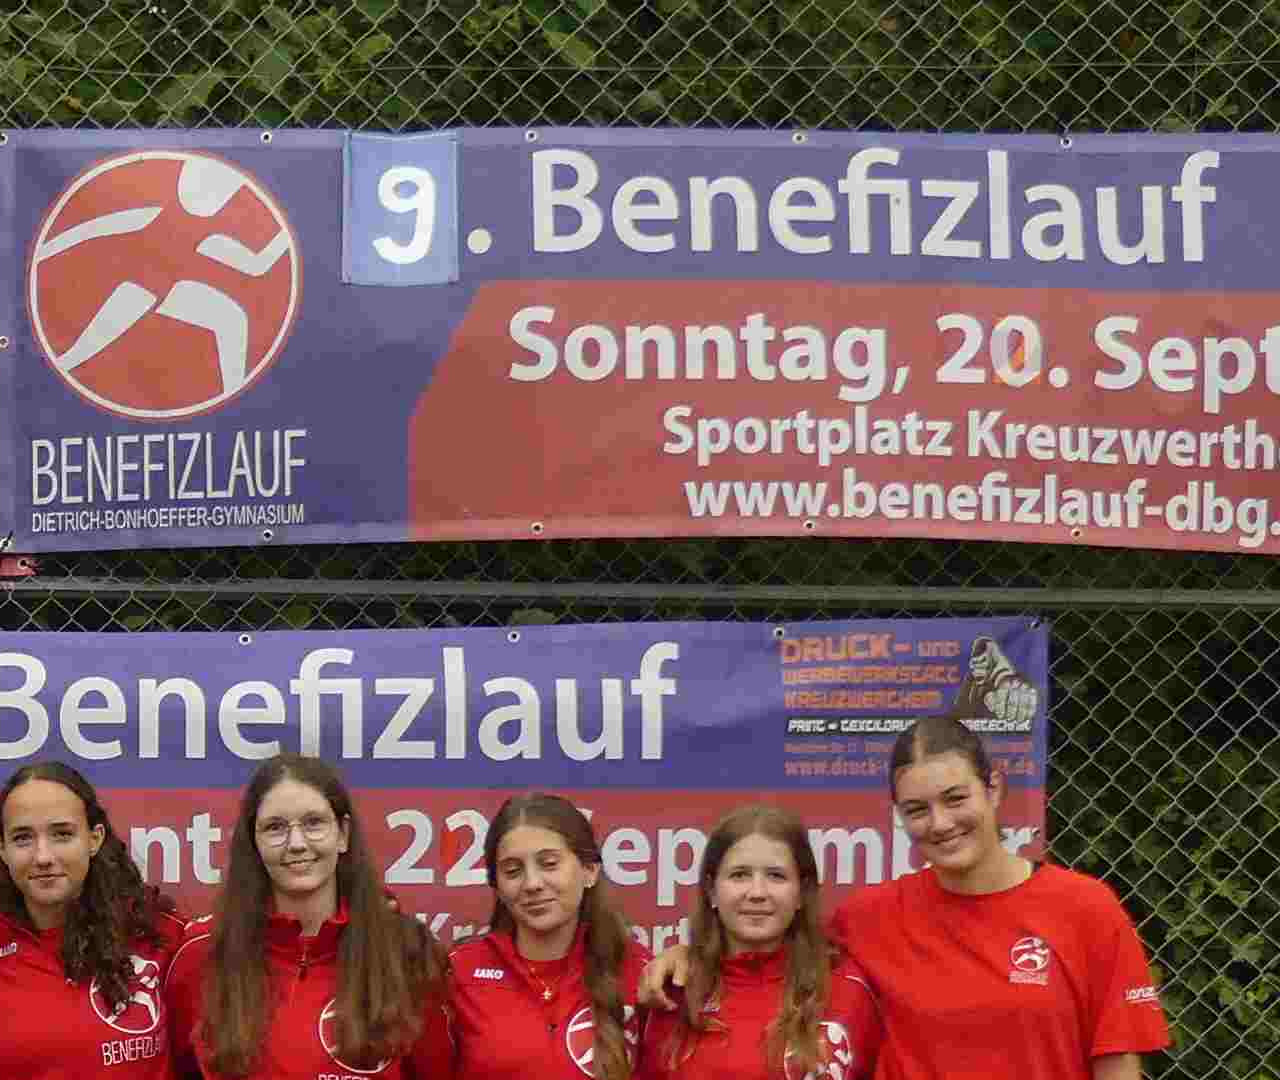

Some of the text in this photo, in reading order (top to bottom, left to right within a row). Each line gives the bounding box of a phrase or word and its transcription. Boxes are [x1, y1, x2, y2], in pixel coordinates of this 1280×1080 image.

[372, 147, 1221, 265] 9. Benefizlauf
[509, 305, 1280, 414] Sonntag, 20. Sept
[31, 429, 307, 505] BENEFIZLAUF
[663, 404, 1280, 471] Sportplatz Kreuzwerth
[31, 503, 305, 533] DIETRICH-BONHOEFFER-GYMNASIUM
